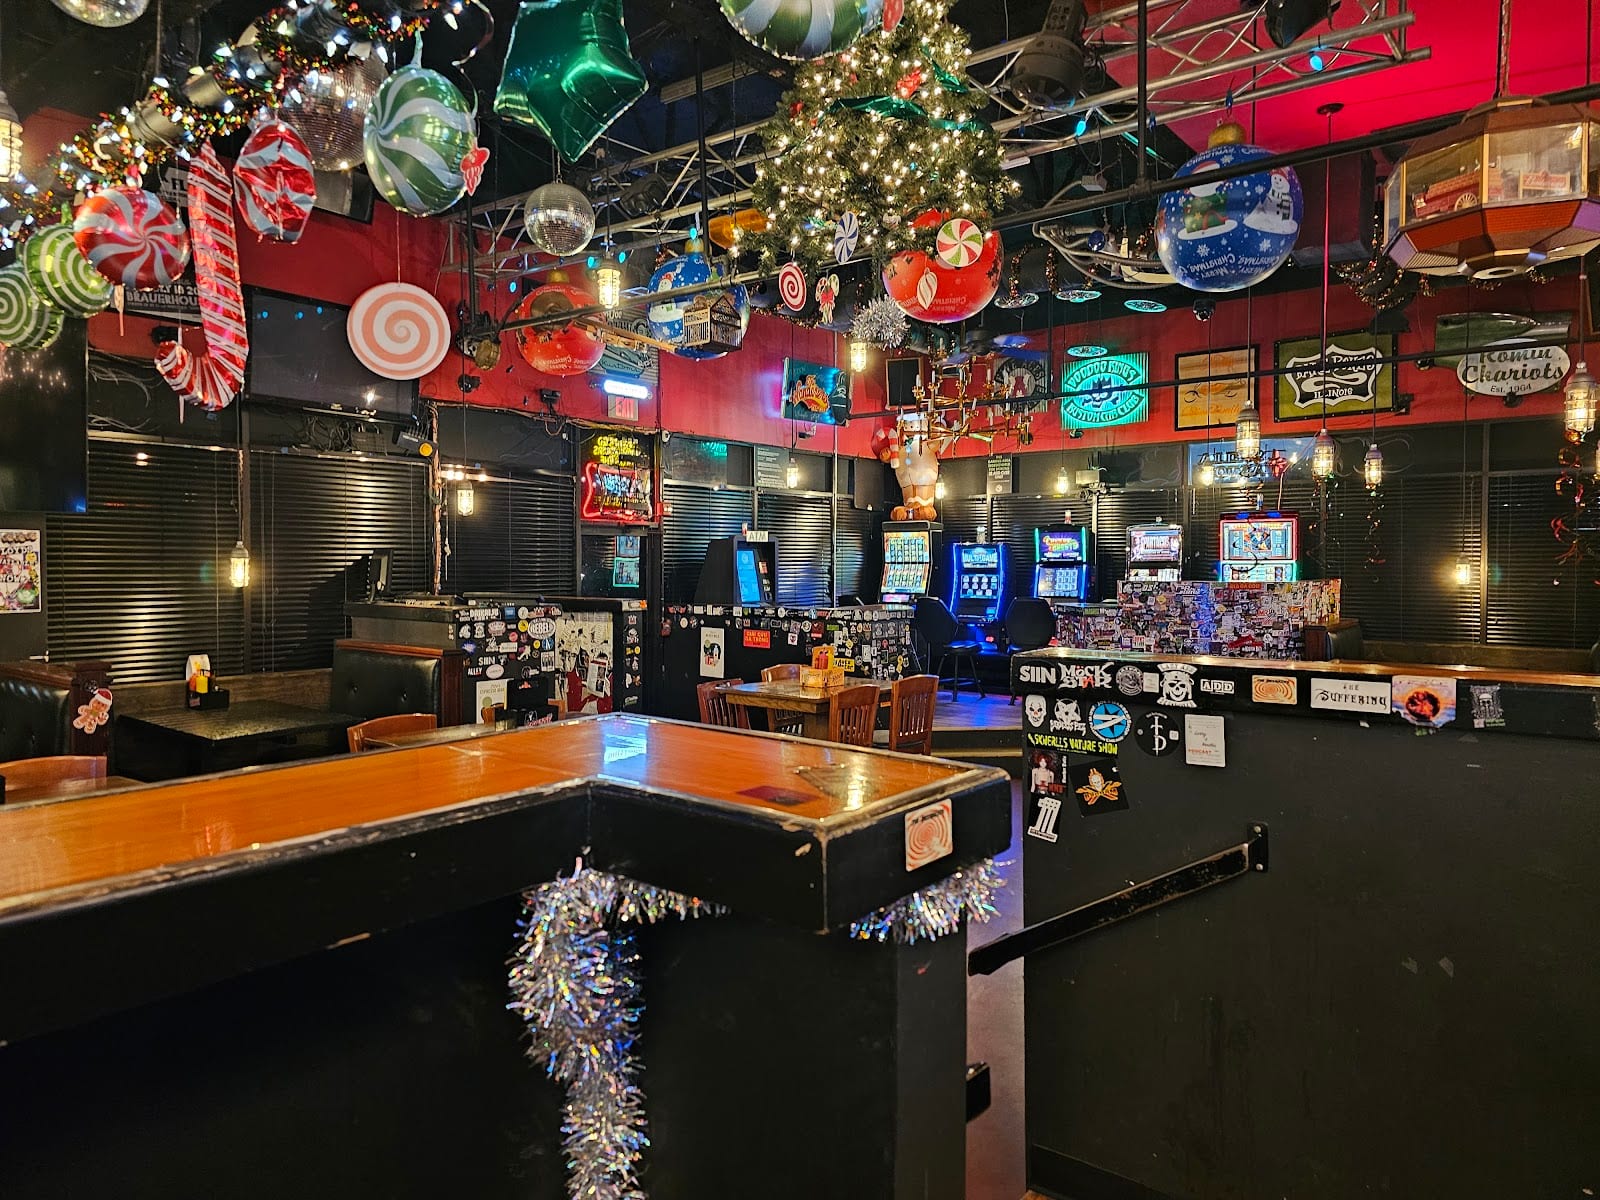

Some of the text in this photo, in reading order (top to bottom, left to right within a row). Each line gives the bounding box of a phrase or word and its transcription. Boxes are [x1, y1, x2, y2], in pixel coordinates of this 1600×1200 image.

[126, 291, 198, 306] BRAUERHOU
[1067, 360, 1107, 389] VOODOO
[1462, 362, 1564, 384] Chariots
[1019, 665, 1057, 685] SIIN
[1202, 680, 1234, 693] ADD
[1315, 689, 1388, 710] SUFFERING
[1098, 742, 1119, 755] SHOW
